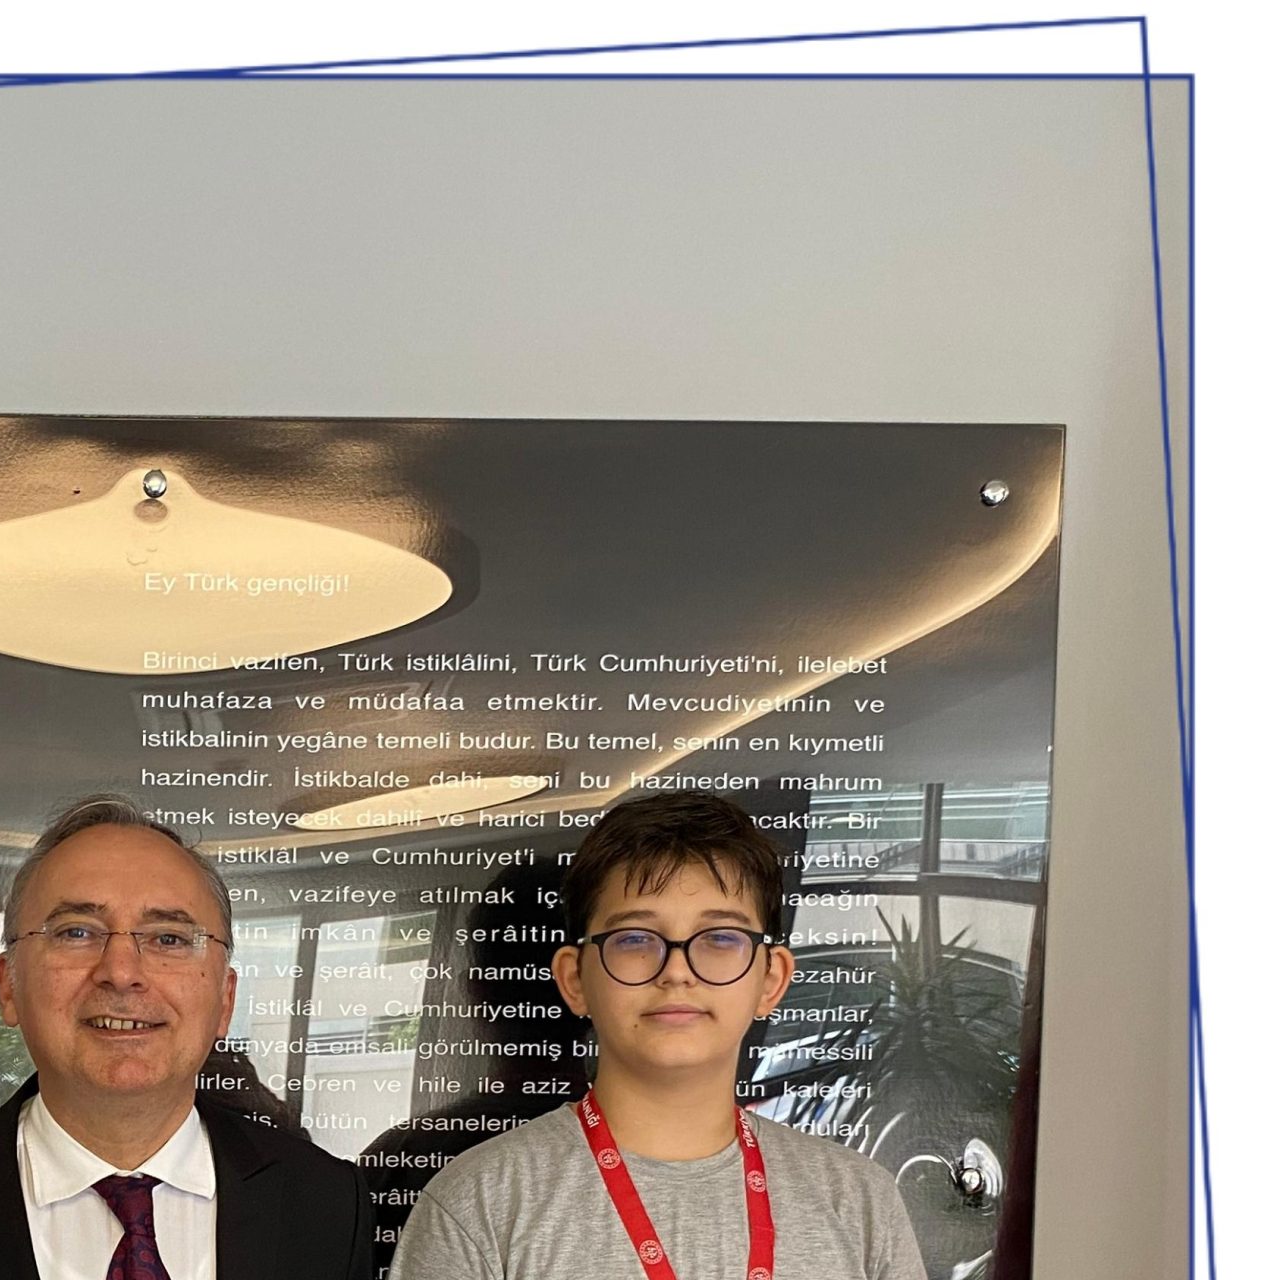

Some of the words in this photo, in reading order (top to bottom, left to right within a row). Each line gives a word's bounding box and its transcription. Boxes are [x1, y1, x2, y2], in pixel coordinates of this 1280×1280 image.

[144, 573, 176, 595] Ey
[185, 573, 239, 592] Türk
[247, 574, 351, 597] gençliği!
[143, 652, 217, 670] Birinci
[230, 653, 326, 674] vazifen,
[338, 653, 393, 671] Türk
[407, 653, 518, 674] istiklâlini,
[530, 654, 586, 672] Türk
[599, 654, 784, 677] Cumhuriyeti'ni,
[798, 656, 887, 674] ilelebet
[142, 692, 273, 710] muhafaza
[295, 696, 326, 710] ve
[349, 693, 465, 711] müdafaa
[487, 693, 604, 711] etmektir.
[628, 694, 831, 716] Mevcudiyetinin
[855, 699, 885, 713] ve
[142, 731, 269, 749] istikbalinin
[277, 731, 368, 753] yegâne
[376, 732, 451, 750] temeli
[460, 732, 535, 750] budur.
[546, 733, 579, 750] Bu
[588, 733, 664, 753] temel,
[673, 734, 740, 751] senin
[749, 737, 779, 751] en
[789, 734, 884, 756] kıymetli
[141, 769, 273, 787] hazinendir.
[294, 767, 410, 788] İstikbalde
[429, 771, 488, 792] dahi,
[509, 772, 560, 789] seni
[580, 772, 610, 789] bu
[630, 772, 759, 790] hazineden
[780, 773, 882, 791] mahrum
[142, 808, 215, 825] etmek
[228, 809, 343, 830] isteyecek
[437, 813, 465, 827] ve
[478, 811, 545, 827] harici
[848, 813, 882, 829] Bir
[218, 846, 297, 863] istiklâl
[320, 851, 350, 865] ve
[372, 848, 535, 869] Cumhuriyet'i
[289, 886, 397, 907] vazifeye
[420, 887, 515, 904] atılmak
[291, 924, 376, 940] imkân
[400, 927, 432, 941] ve
[275, 965, 303, 979] ve
[319, 961, 393, 982] şerâit,
[410, 964, 453, 983] çok
[791, 966, 877, 984] ezahür
[248, 996, 322, 1017] İstiklâl
[339, 1003, 367, 1017] ve
[384, 1000, 563, 1023] Cumhuriyetine
[215, 1037, 319, 1057] dünyada
[330, 1038, 408, 1054] emsali
[419, 1039, 562, 1061] görülmemiş
[749, 1043, 873, 1061] mümessili
[268, 1074, 356, 1092] Cebren
[373, 1079, 401, 1093] ve
[420, 1076, 460, 1093] hile
[478, 1077, 505, 1094] ile
[522, 1078, 571, 1094] aziz
[784, 1081, 871, 1098] kaleleri
[301, 1112, 367, 1129] bütün
